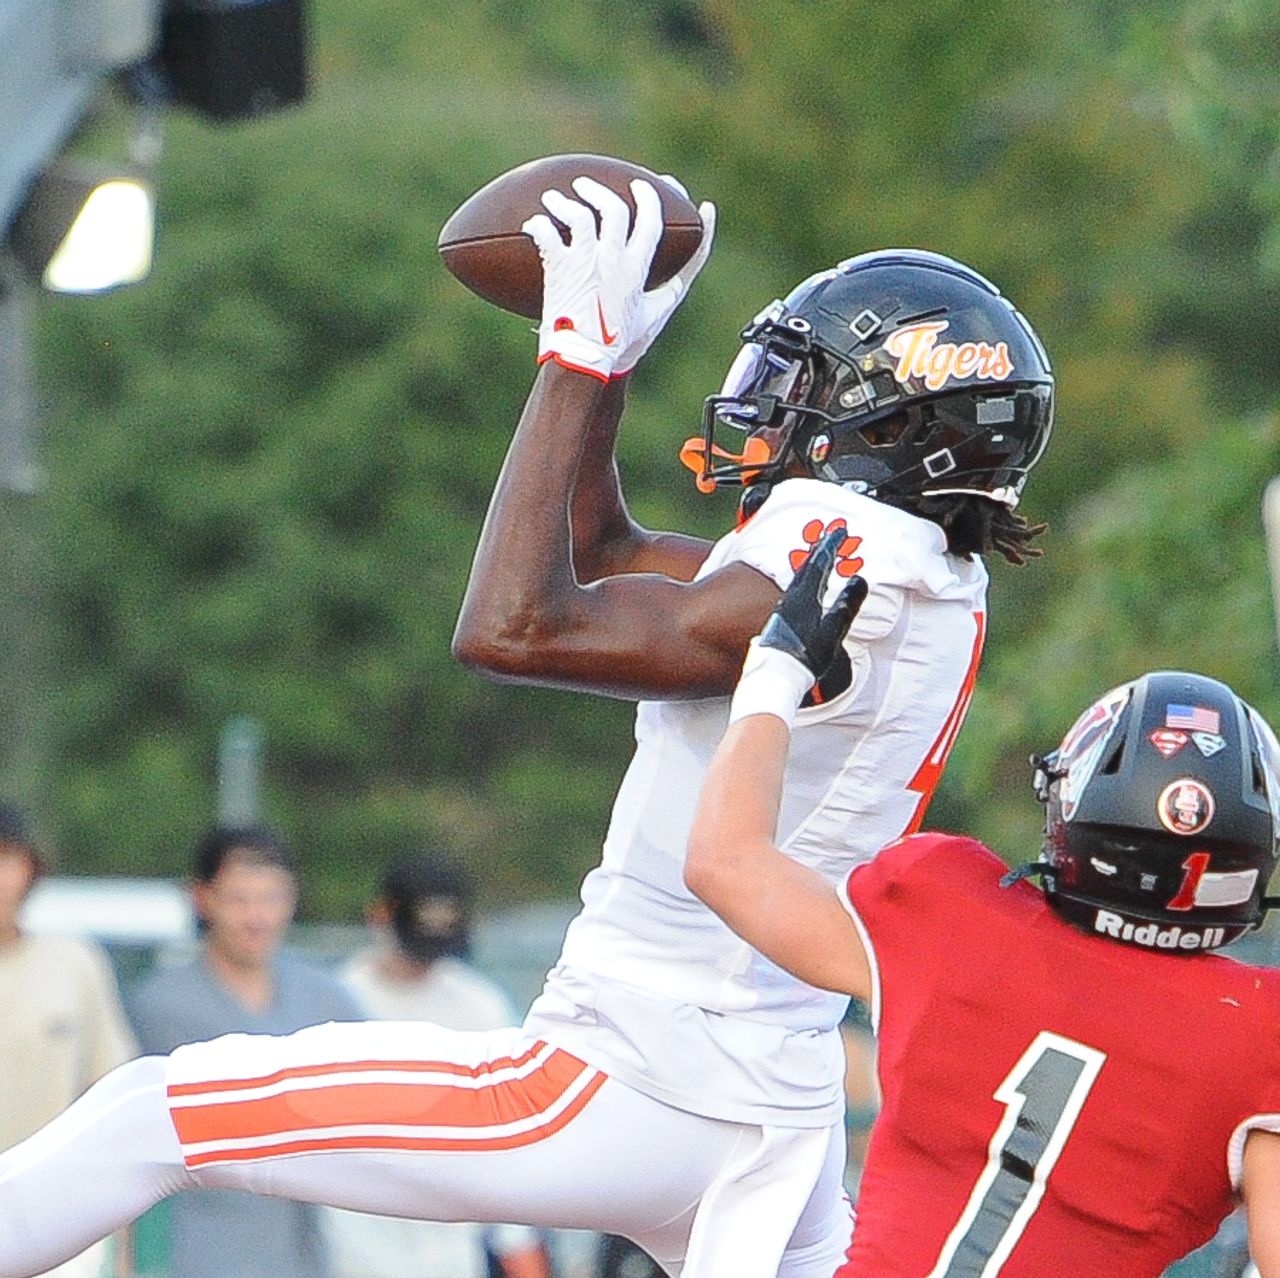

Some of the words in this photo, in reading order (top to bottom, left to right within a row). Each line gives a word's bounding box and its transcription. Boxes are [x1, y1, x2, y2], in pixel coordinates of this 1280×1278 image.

[882, 320, 1015, 391] Tigers
[1166, 852, 1211, 911] 1
[1094, 909, 1225, 949] Riddell
